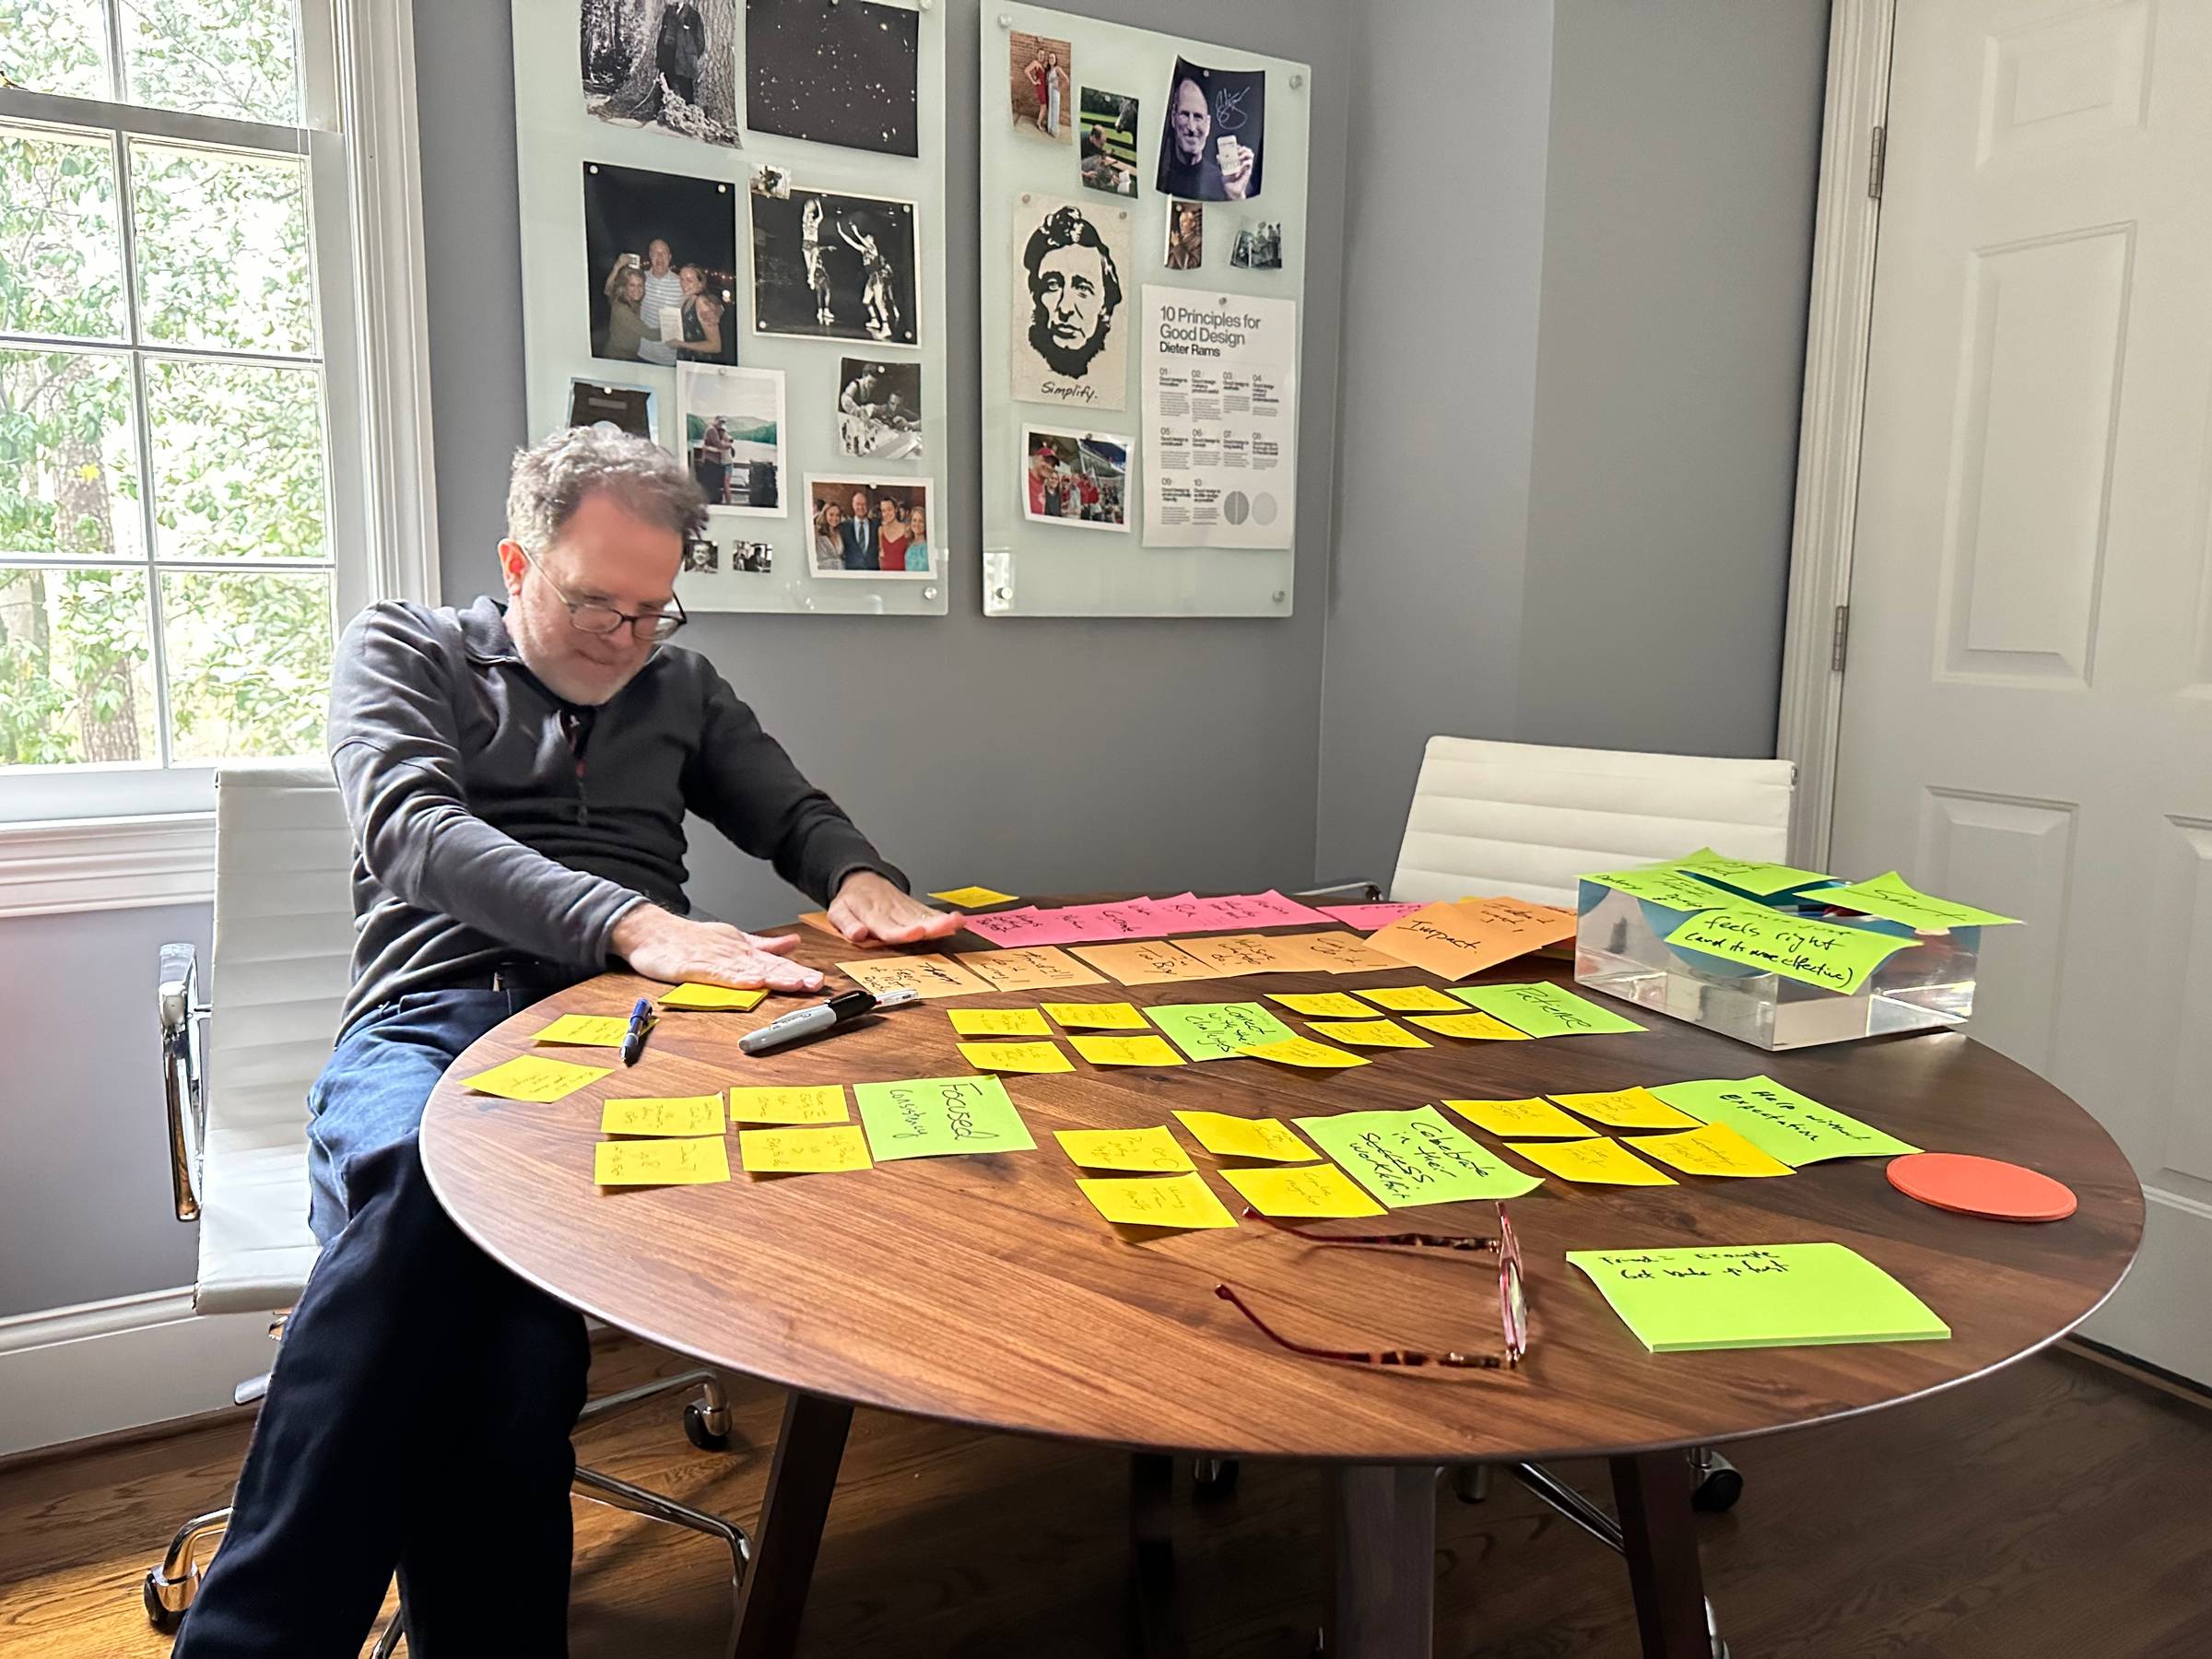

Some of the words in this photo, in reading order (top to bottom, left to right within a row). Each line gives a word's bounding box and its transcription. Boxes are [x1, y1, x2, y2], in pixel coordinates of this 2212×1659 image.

[1160, 306, 1175, 322] 10
[1178, 308, 1241, 329] Principles
[1243, 314, 1261, 329] for
[1159, 324, 1196, 341] Good
[1199, 327, 1245, 347] Design
[1159, 341, 1189, 355] Dieter
[1191, 344, 1220, 357] Rams
[1775, 933, 1845, 956] right
[939, 1083, 1000, 1141] Focused
